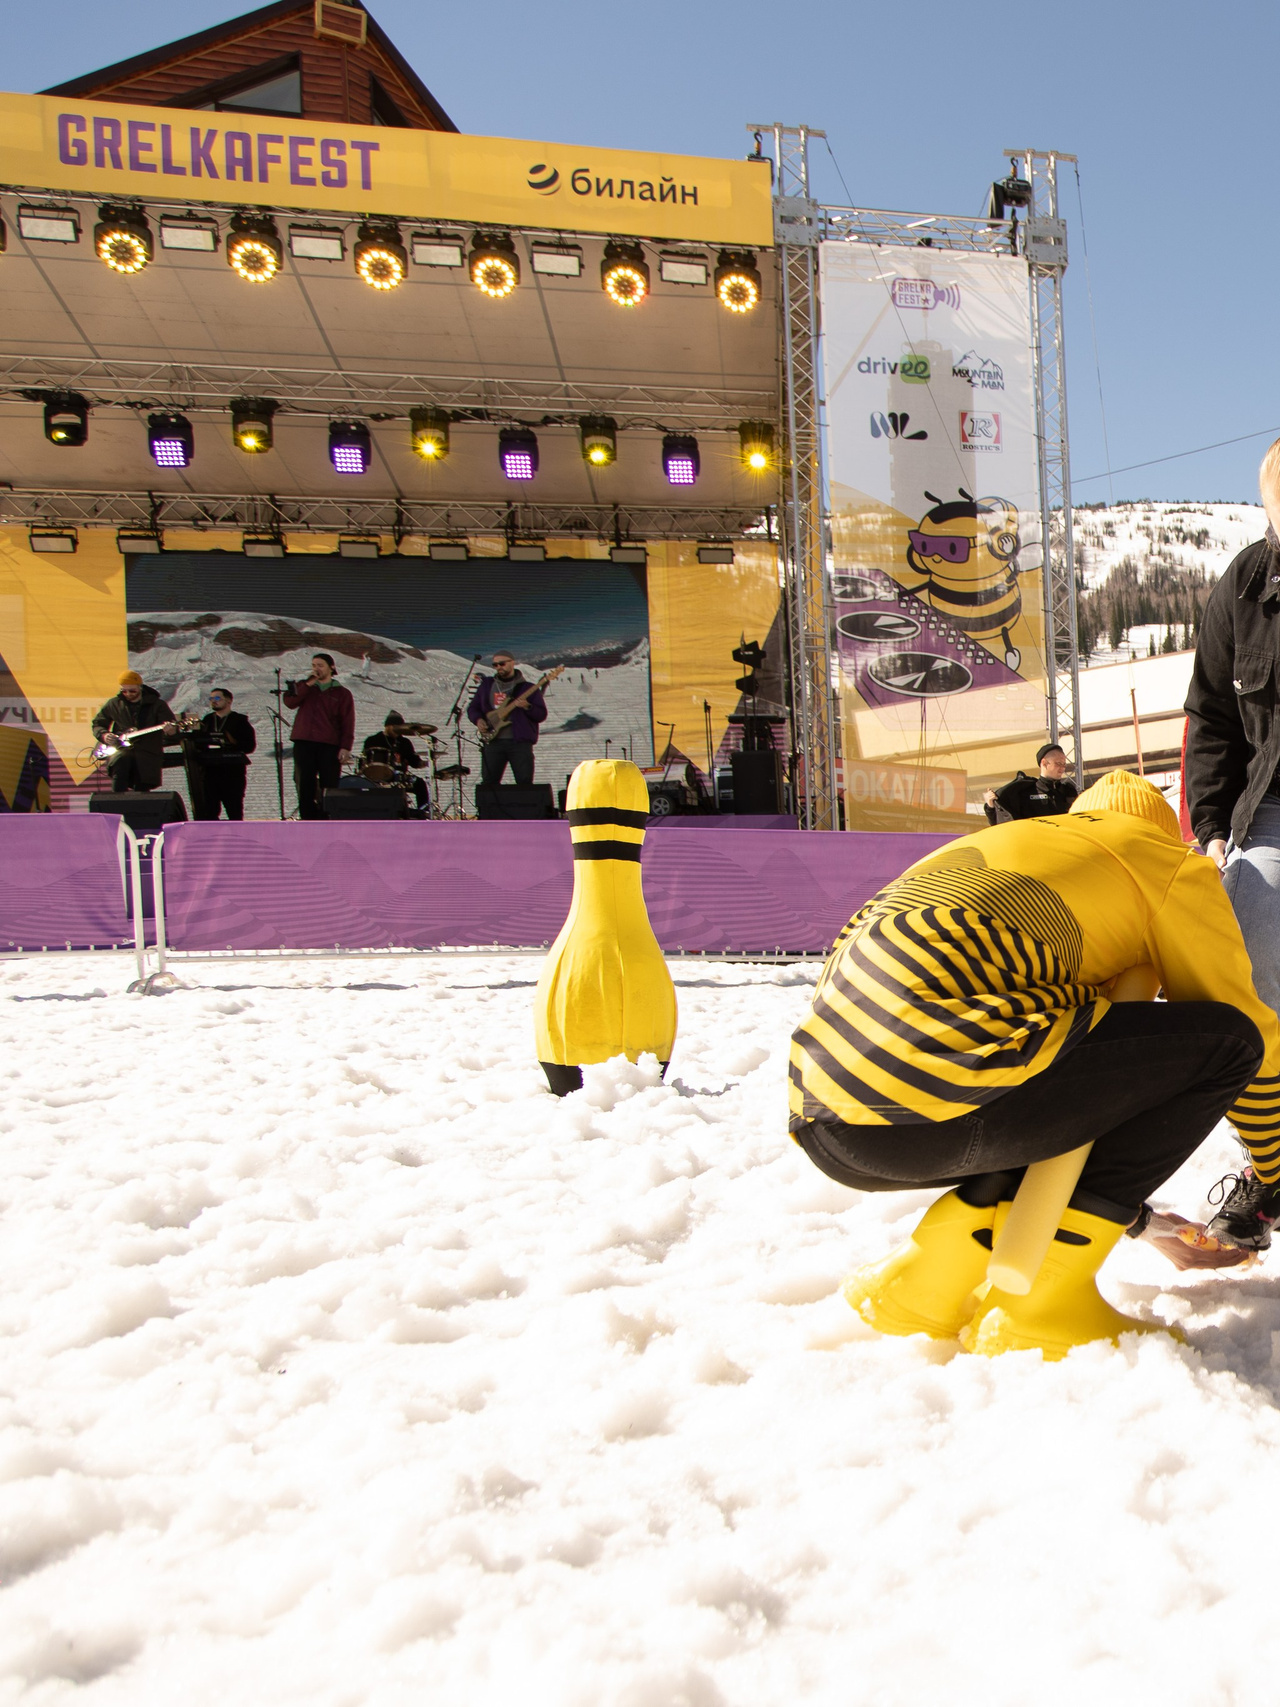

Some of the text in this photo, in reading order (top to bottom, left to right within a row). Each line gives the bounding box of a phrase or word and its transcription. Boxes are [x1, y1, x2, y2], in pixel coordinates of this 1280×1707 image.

[58, 113, 381, 191] GRELKAFEST
[571, 168, 699, 206] билайн
[898, 281, 932, 294] GRELKA
[898, 294, 922, 305] FEST
[857, 356, 931, 380] drivee
[952, 366, 1004, 381] MOUNTAIN
[981, 380, 1005, 391] MAN
[962, 443, 1001, 451] ROSTIC'S
